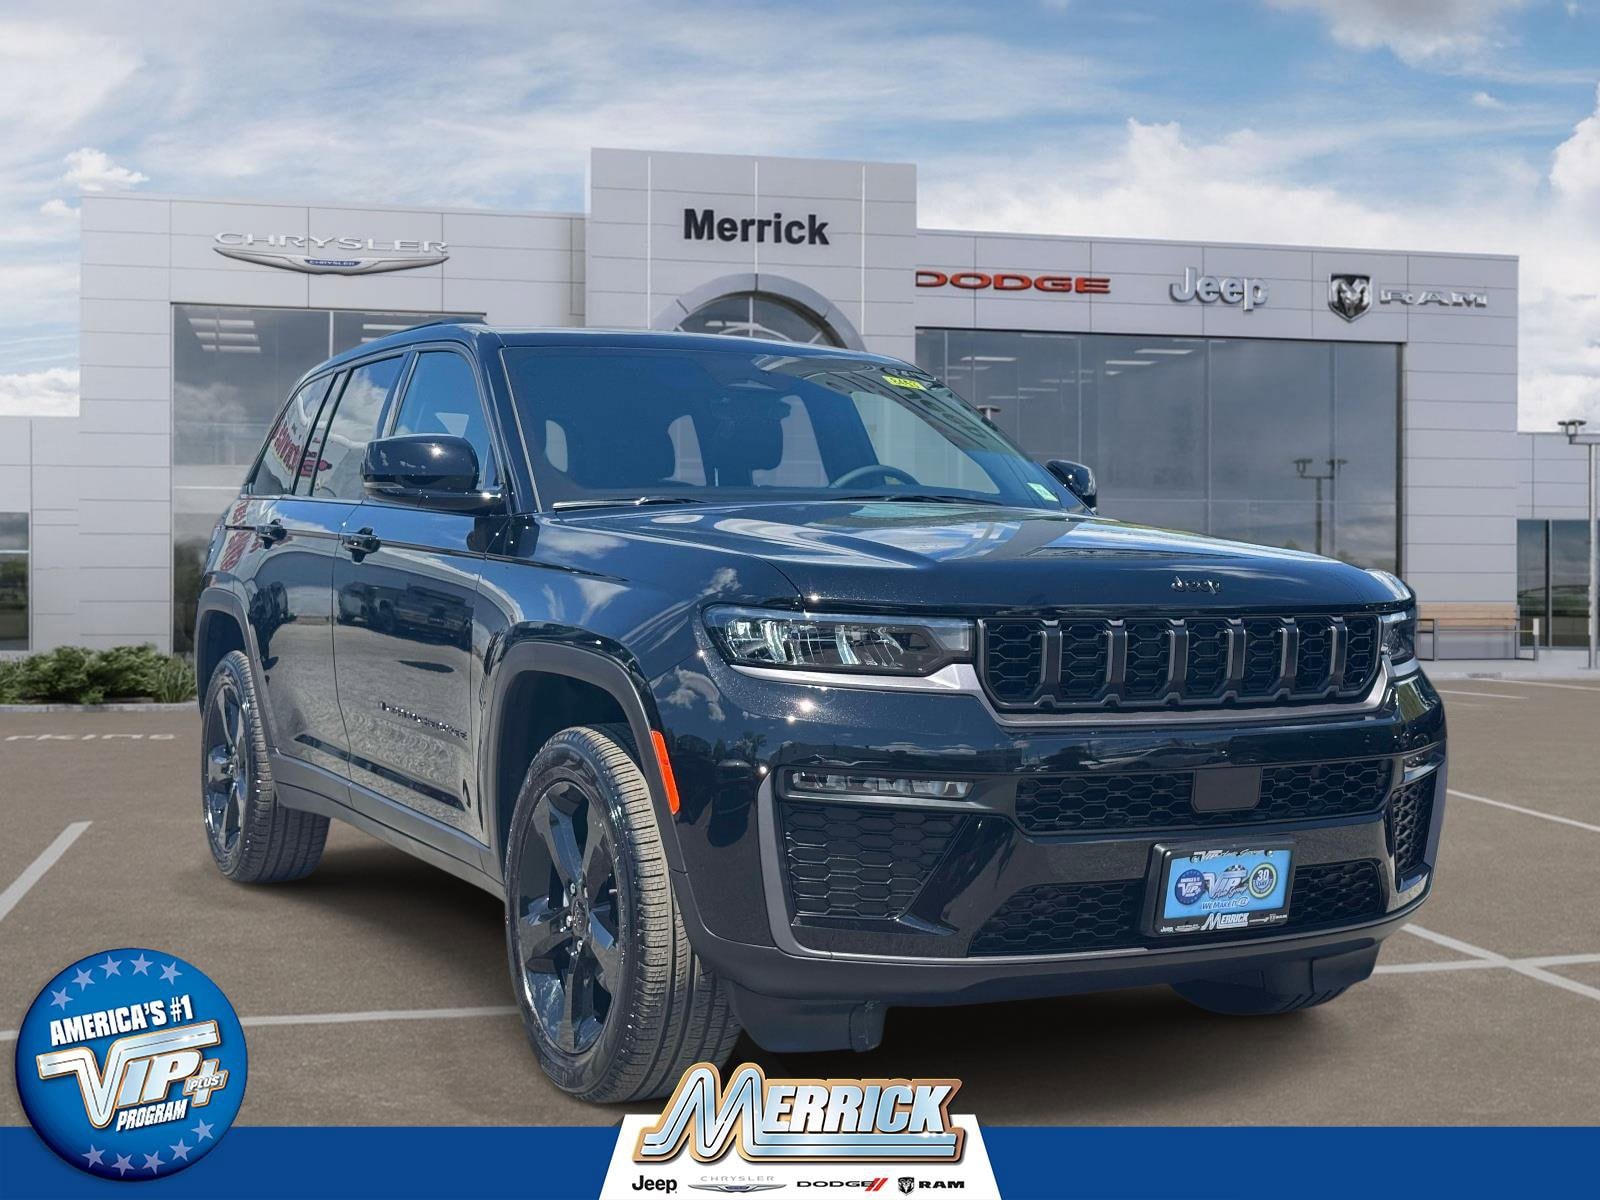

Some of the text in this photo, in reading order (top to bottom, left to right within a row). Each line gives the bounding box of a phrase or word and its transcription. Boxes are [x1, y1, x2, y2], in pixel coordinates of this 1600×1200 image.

[683, 208, 830, 245] Merrick
[213, 232, 449, 252] CHRYSLER
[915, 271, 1111, 294] DODGE
[1169, 267, 1270, 312] Jeep
[1379, 289, 1488, 308] RAM
[1256, 869, 1270, 880] 30
[1200, 912, 1250, 930] MERRICK
